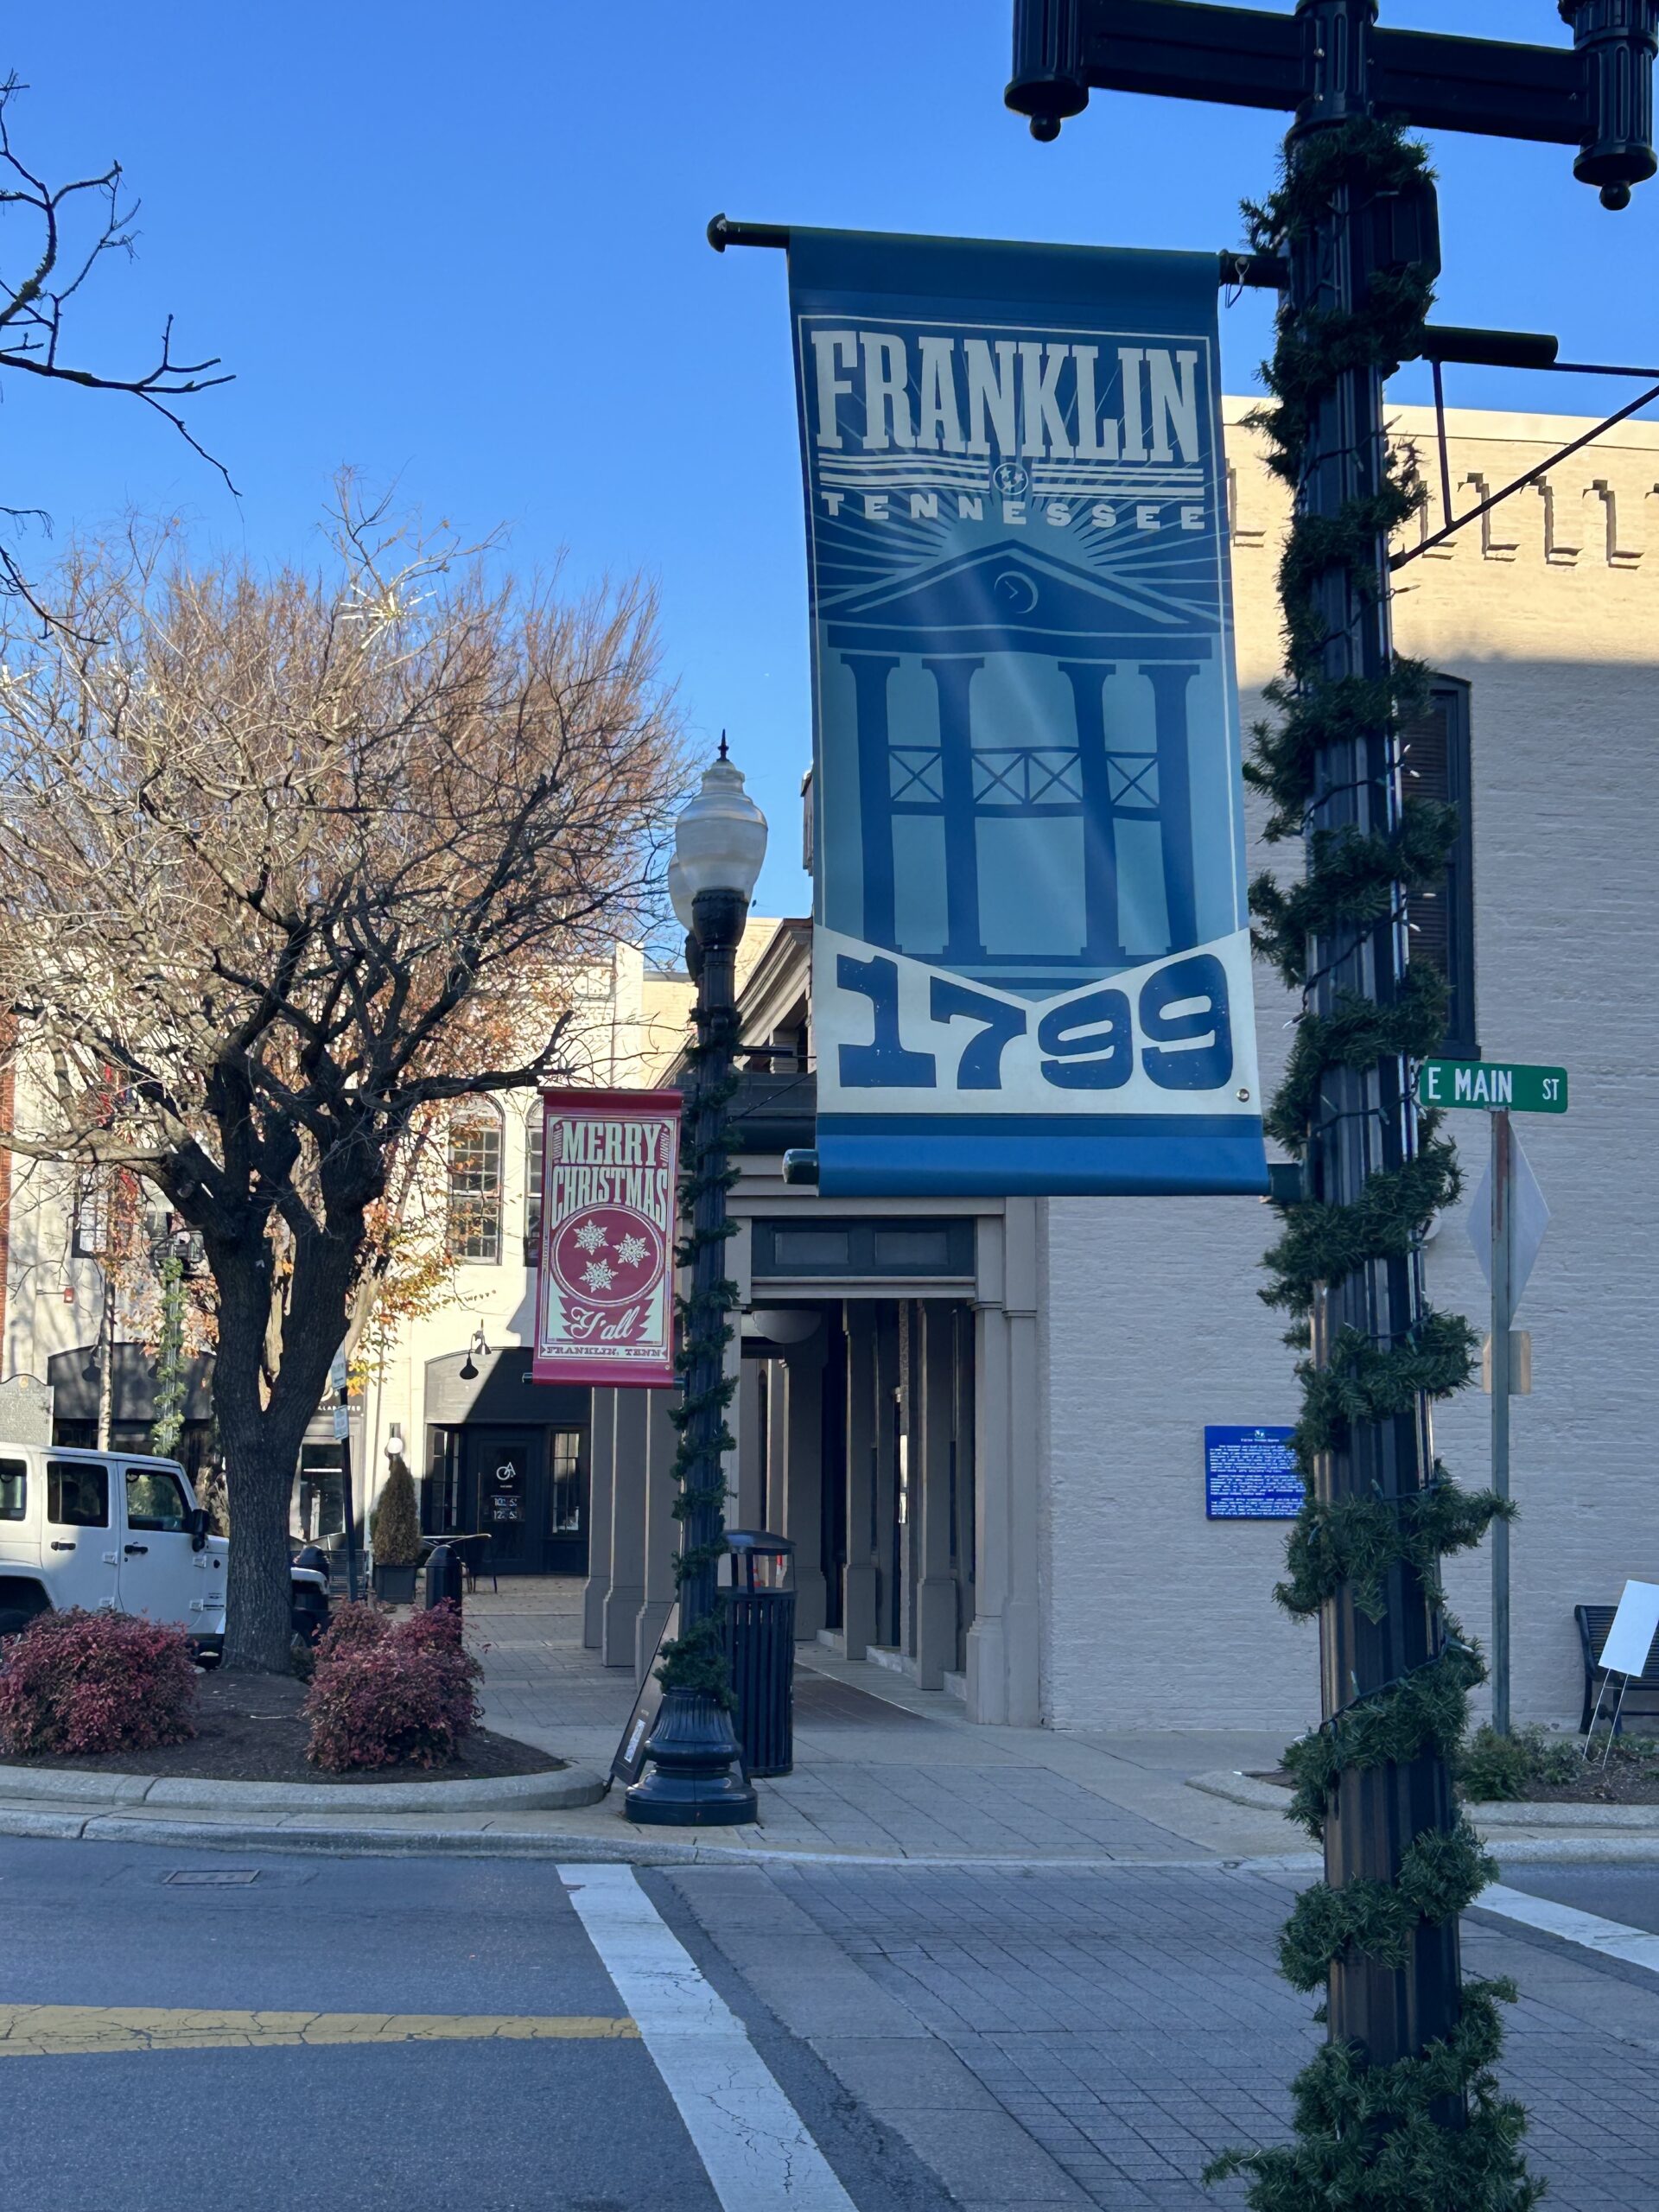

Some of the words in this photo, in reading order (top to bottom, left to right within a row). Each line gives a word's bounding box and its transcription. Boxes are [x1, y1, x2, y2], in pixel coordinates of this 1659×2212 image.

[810, 330, 1199, 463] FRANKLIN
[821, 491, 1205, 531] TENNESSEE
[836, 952, 1234, 1090] 1799
[1428, 1066, 1441, 1100] E
[1454, 1068, 1512, 1103] MAIN
[1541, 1077, 1560, 1101] ST
[561, 1121, 662, 1166] MERRY
[550, 1166, 668, 1232] CHRISTMAS
[569, 1305, 641, 1340] Y'all
[625, 1348, 661, 1357] TENN
